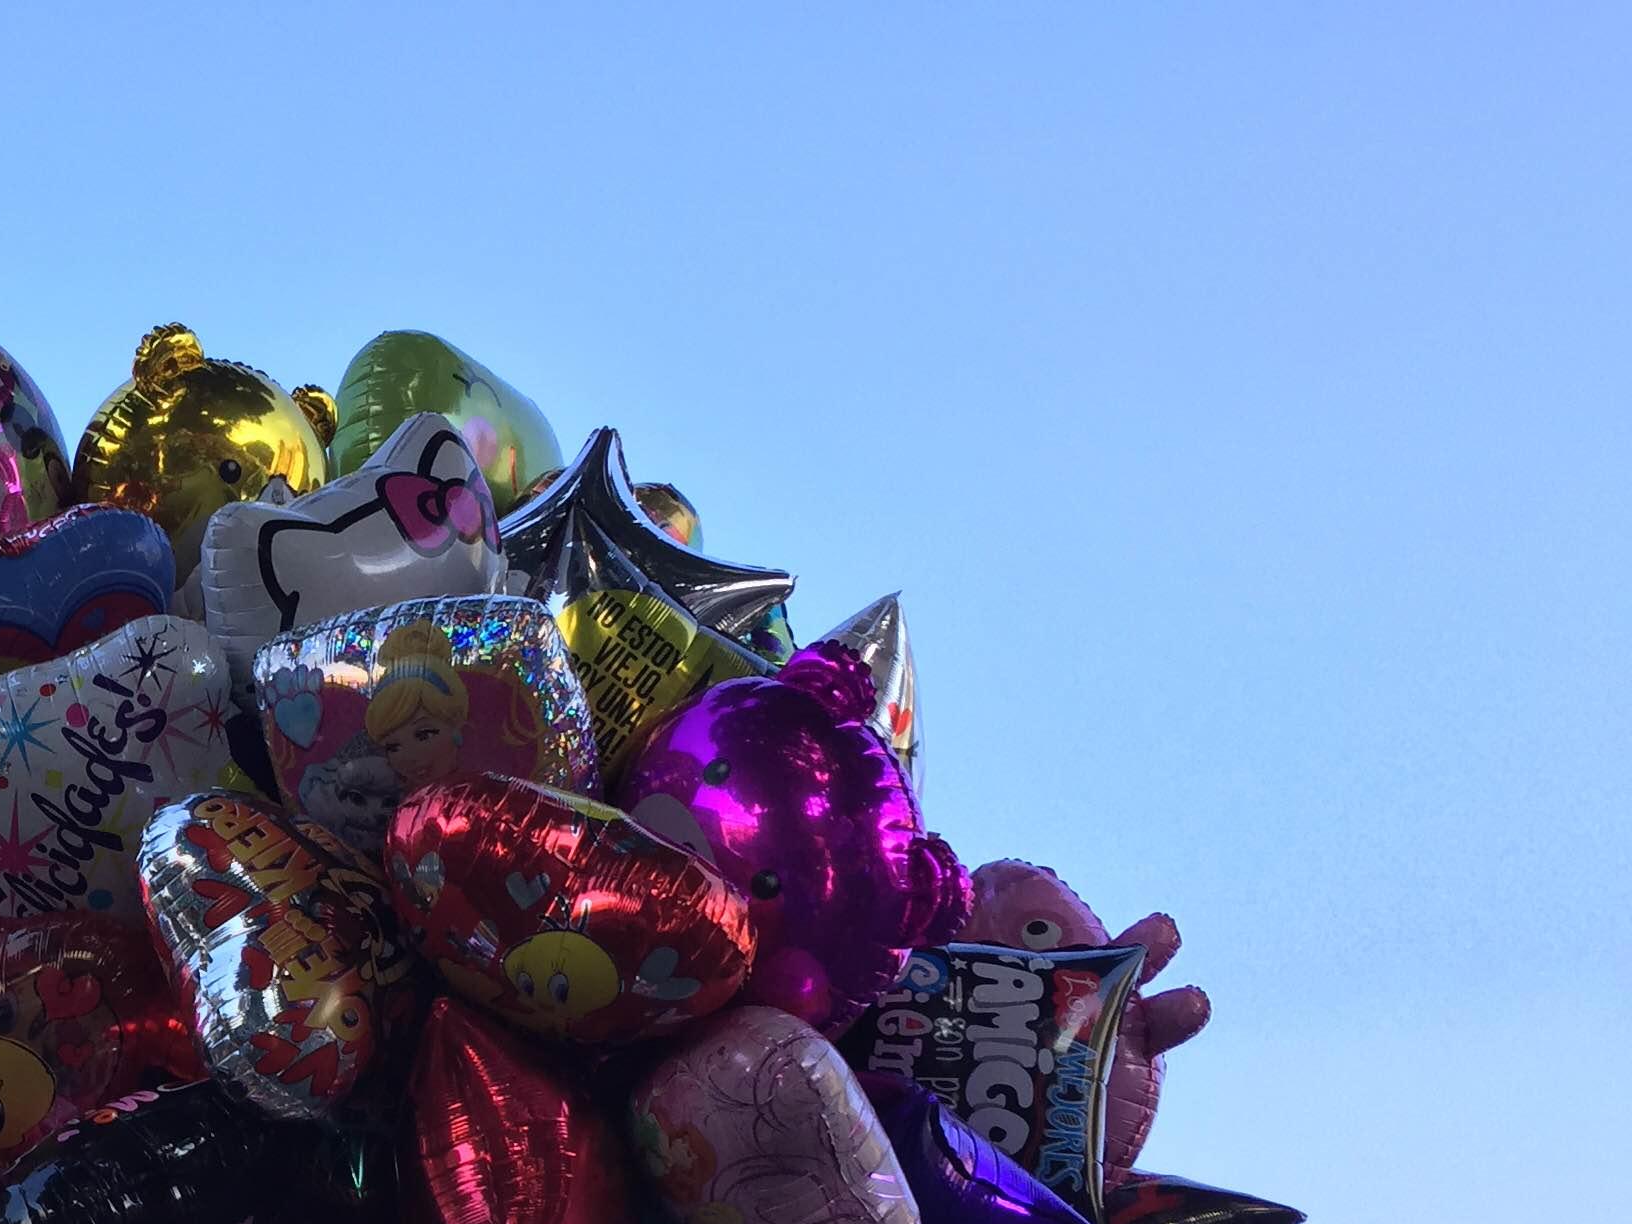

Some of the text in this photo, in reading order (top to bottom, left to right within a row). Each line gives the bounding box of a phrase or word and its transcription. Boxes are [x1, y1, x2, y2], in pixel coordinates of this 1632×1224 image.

[587, 592, 687, 675] NO ESTOY
[596, 682, 647, 735] UNA
[1040, 1038, 1097, 1193] MEJORES
